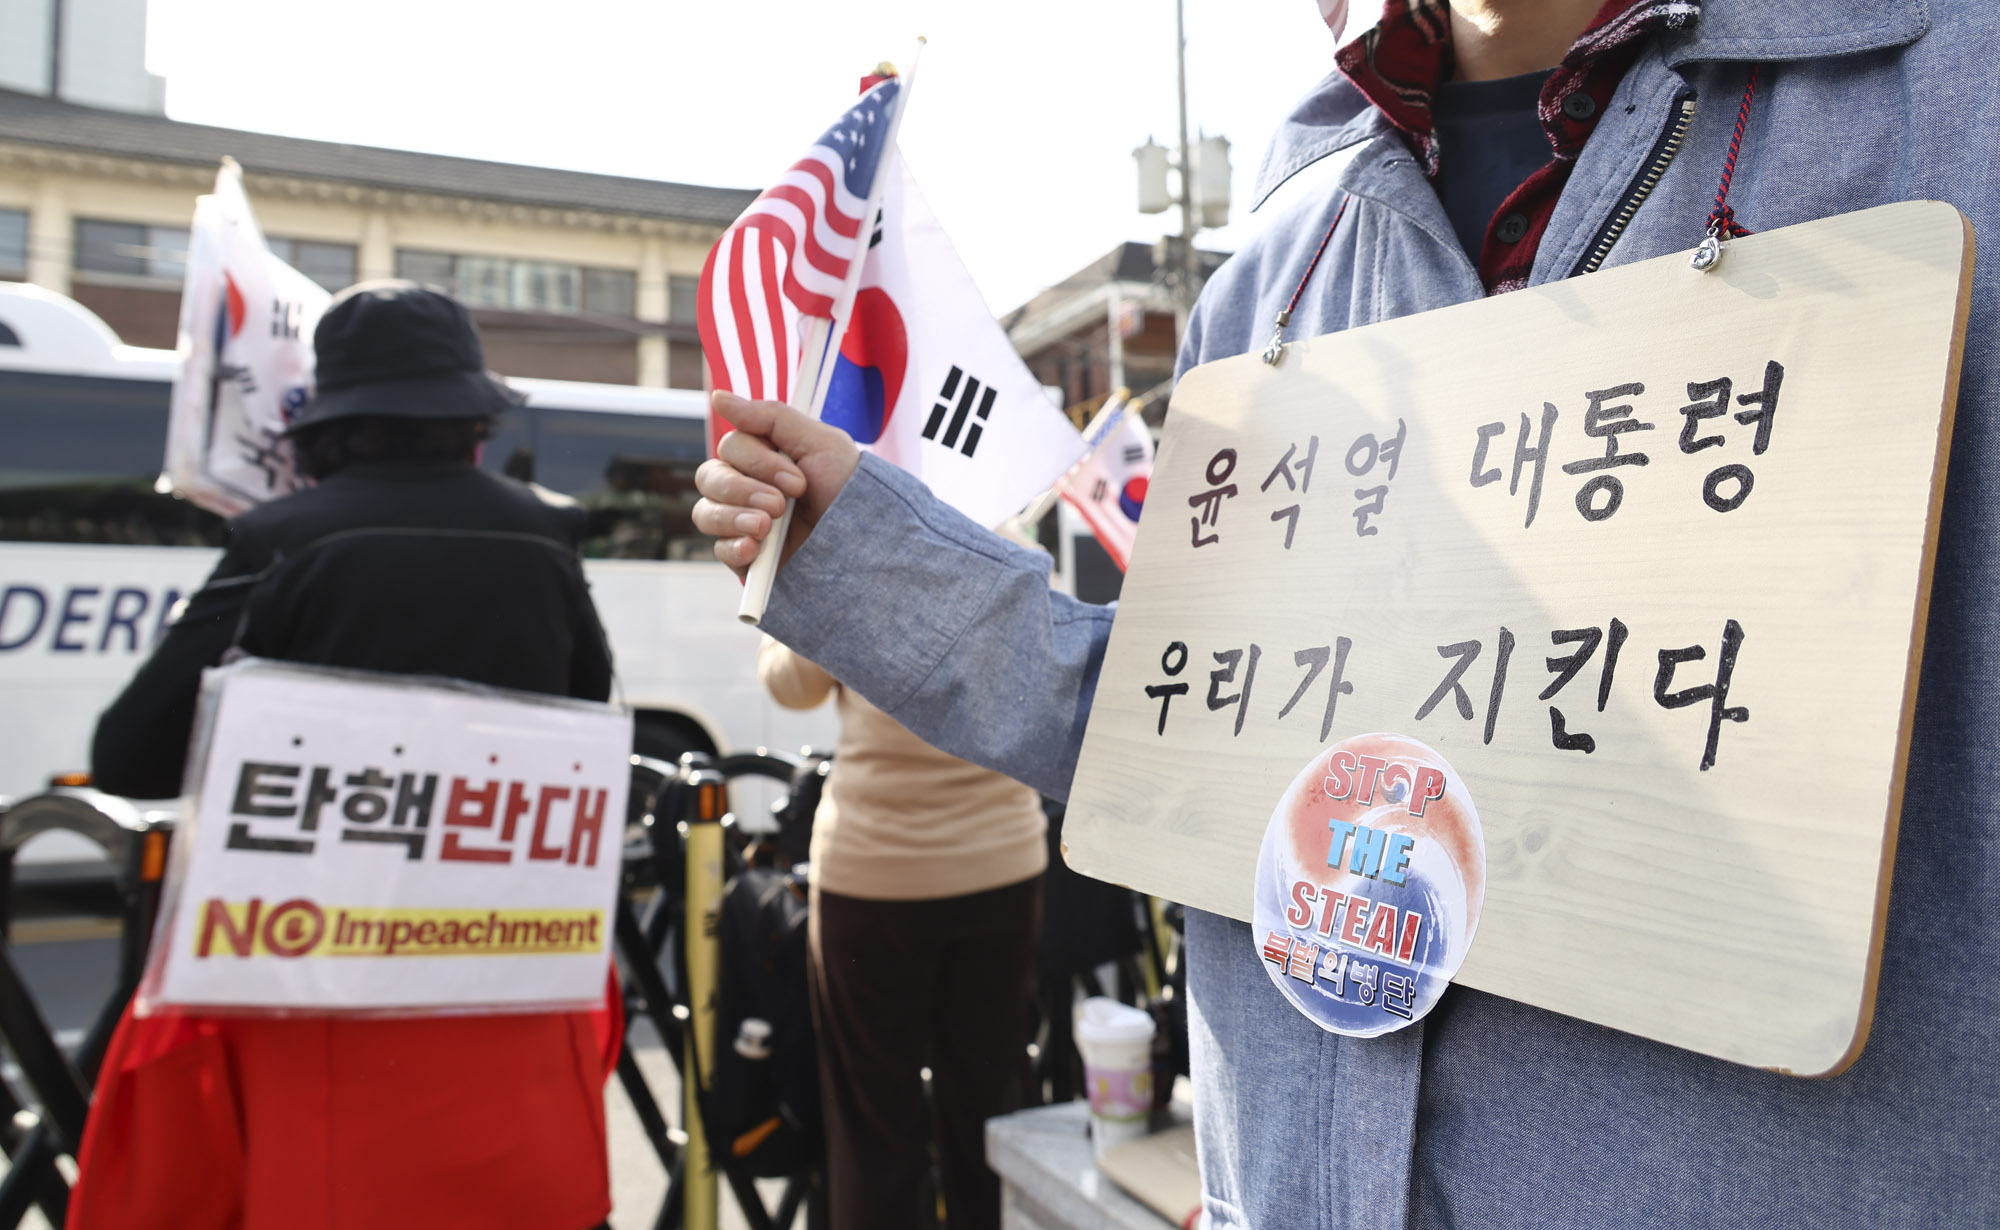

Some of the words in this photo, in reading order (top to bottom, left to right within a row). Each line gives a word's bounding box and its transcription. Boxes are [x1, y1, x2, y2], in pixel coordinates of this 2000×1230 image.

[1187, 416, 1408, 550] 윤석열
[1469, 359, 1785, 530] 대통령
[1144, 635, 1355, 744] 우리가
[1414, 617, 1751, 773] 지킨다
[225, 761, 609, 868] 탄핵반대
[1323, 750, 1447, 817] STOP
[1326, 818, 1415, 888] THE
[195, 897, 327, 959] NO
[332, 910, 600, 956] Impeachment
